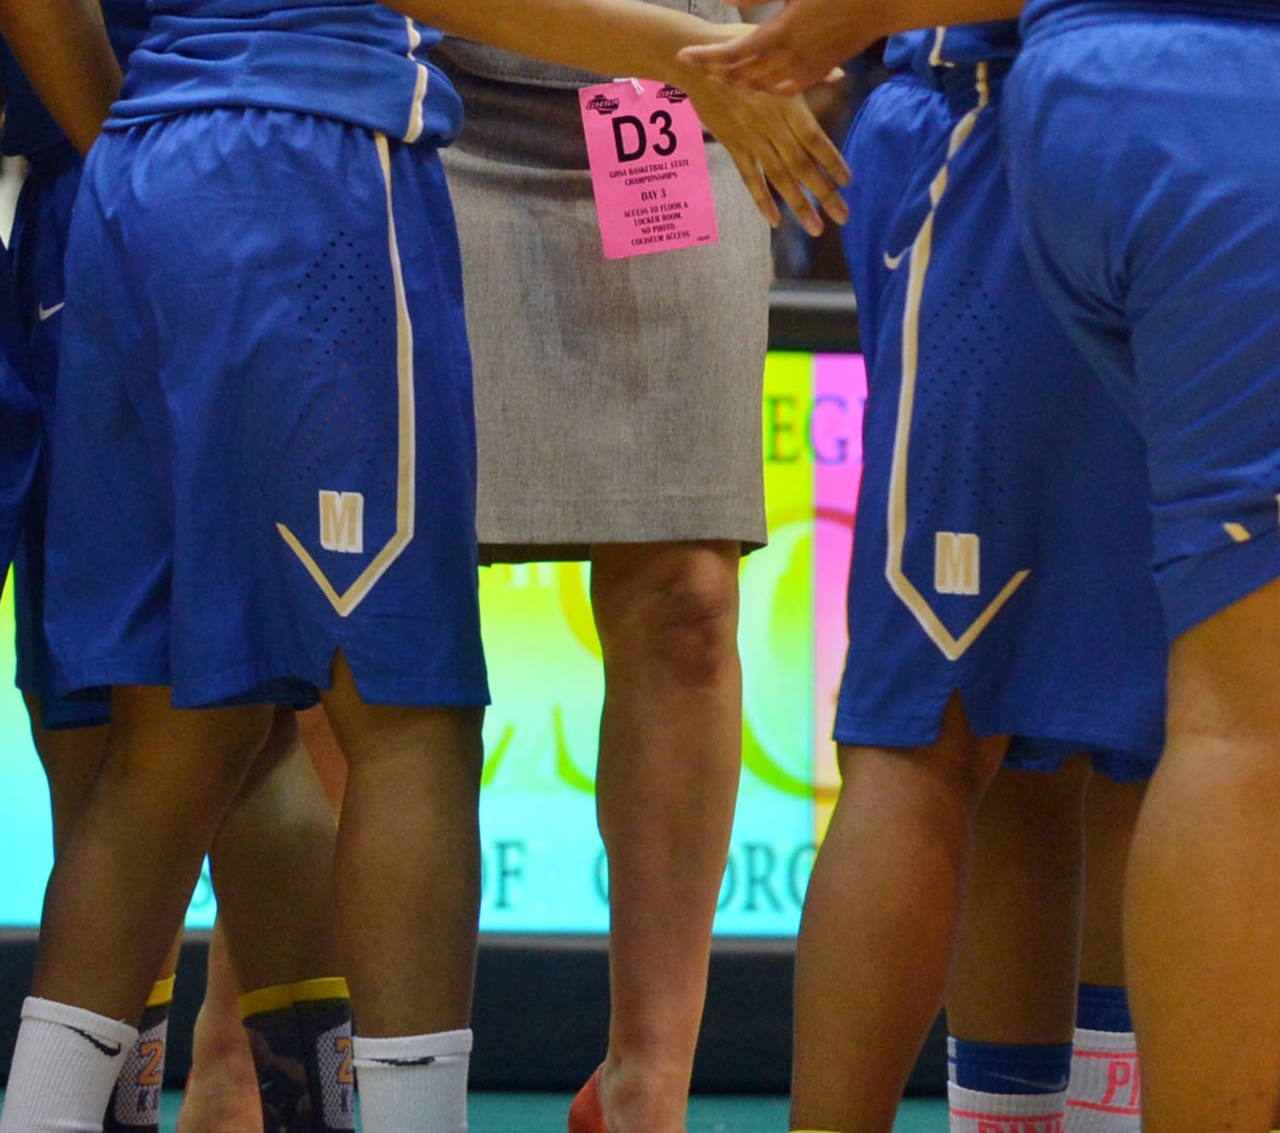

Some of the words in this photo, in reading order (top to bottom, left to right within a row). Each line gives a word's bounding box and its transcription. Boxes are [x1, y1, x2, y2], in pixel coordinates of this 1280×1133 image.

[612, 110, 677, 163] D3
[628, 162, 668, 176] BASKETBALL
[670, 159, 689, 169] STATE
[624, 171, 678, 186] CHAMPIONSHIPS
[641, 190, 657, 202] DAY
[660, 188, 667, 198] 3
[624, 208, 649, 218] ACCESS
[650, 206, 659, 214] TO
[660, 203, 682, 213] FLOOR
[634, 215, 660, 227] LOCKER
[631, 236, 664, 246] COLISEUM
[666, 230, 691, 241] ACCESS
[641, 227, 651, 235] NO
[318, 490, 364, 554] M
[933, 531, 980, 596] M
